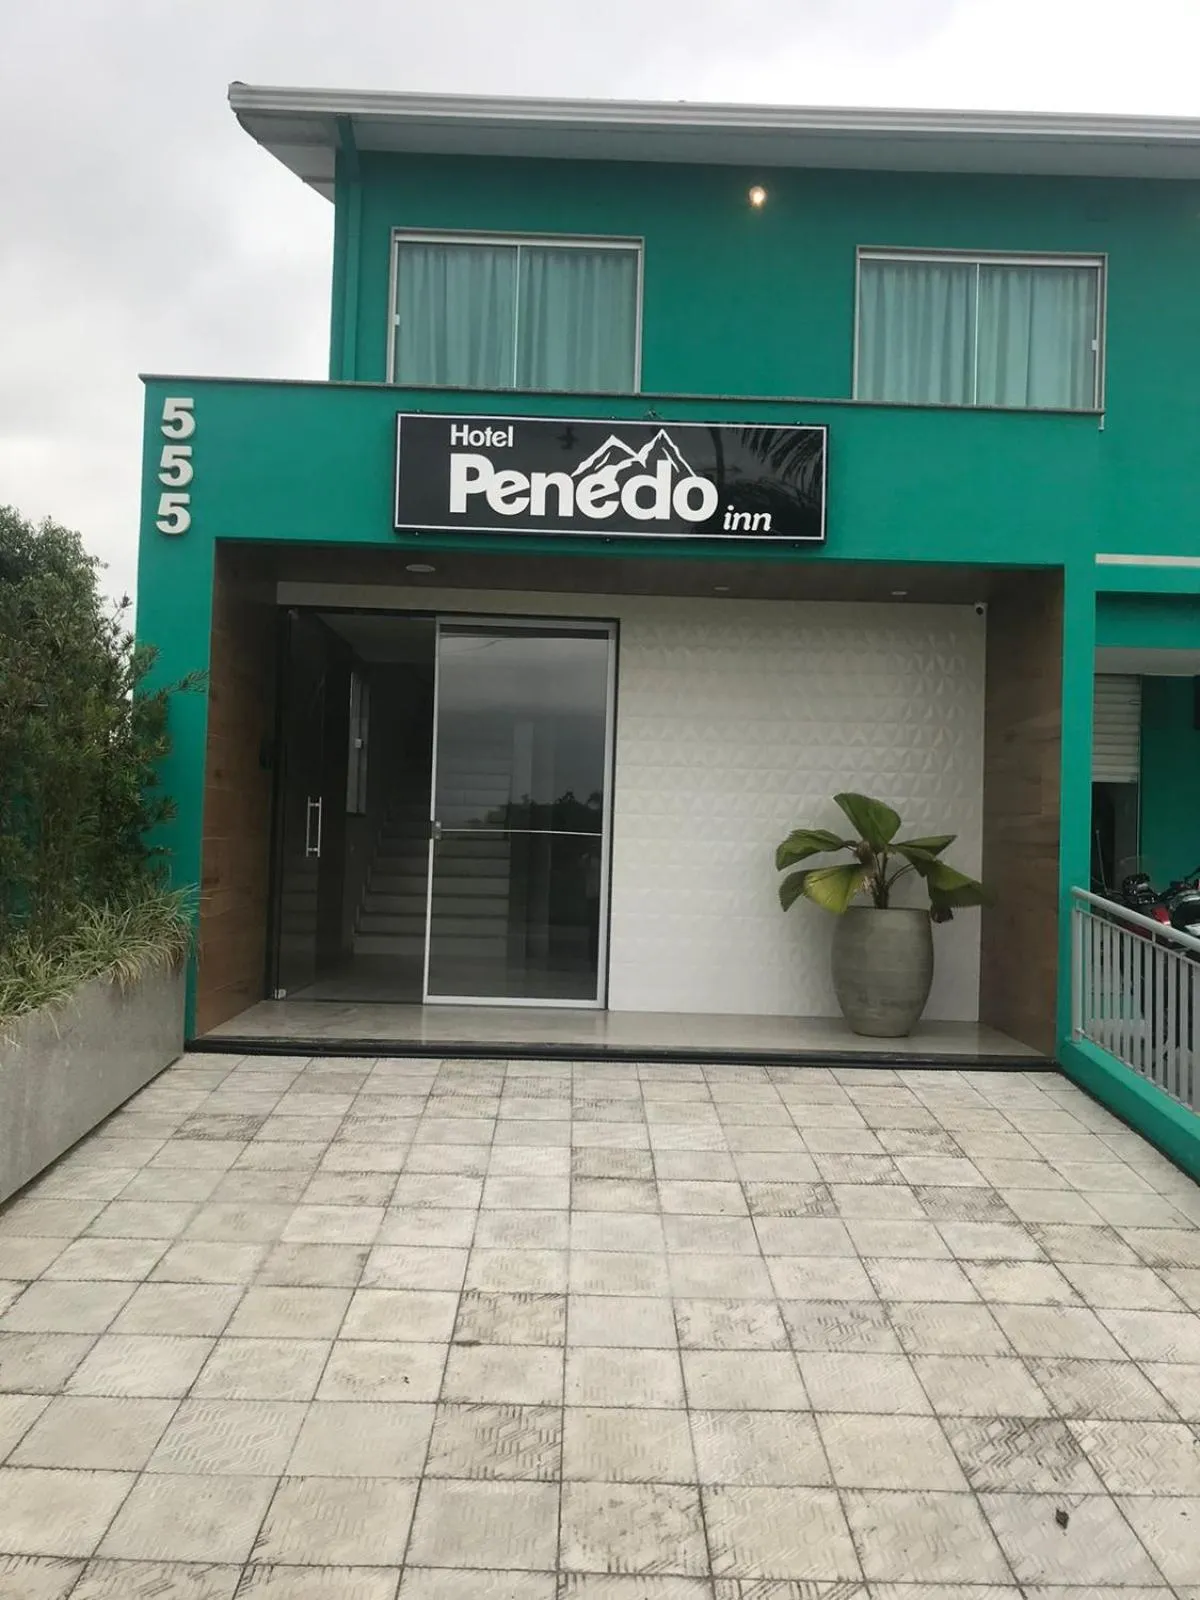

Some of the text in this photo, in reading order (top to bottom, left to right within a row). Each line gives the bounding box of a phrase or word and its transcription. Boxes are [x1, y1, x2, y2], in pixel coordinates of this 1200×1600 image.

[450, 424, 514, 448] Hotel
[156, 397, 196, 535] 555
[449, 453, 719, 522] Penedo
[722, 504, 772, 532] inn
